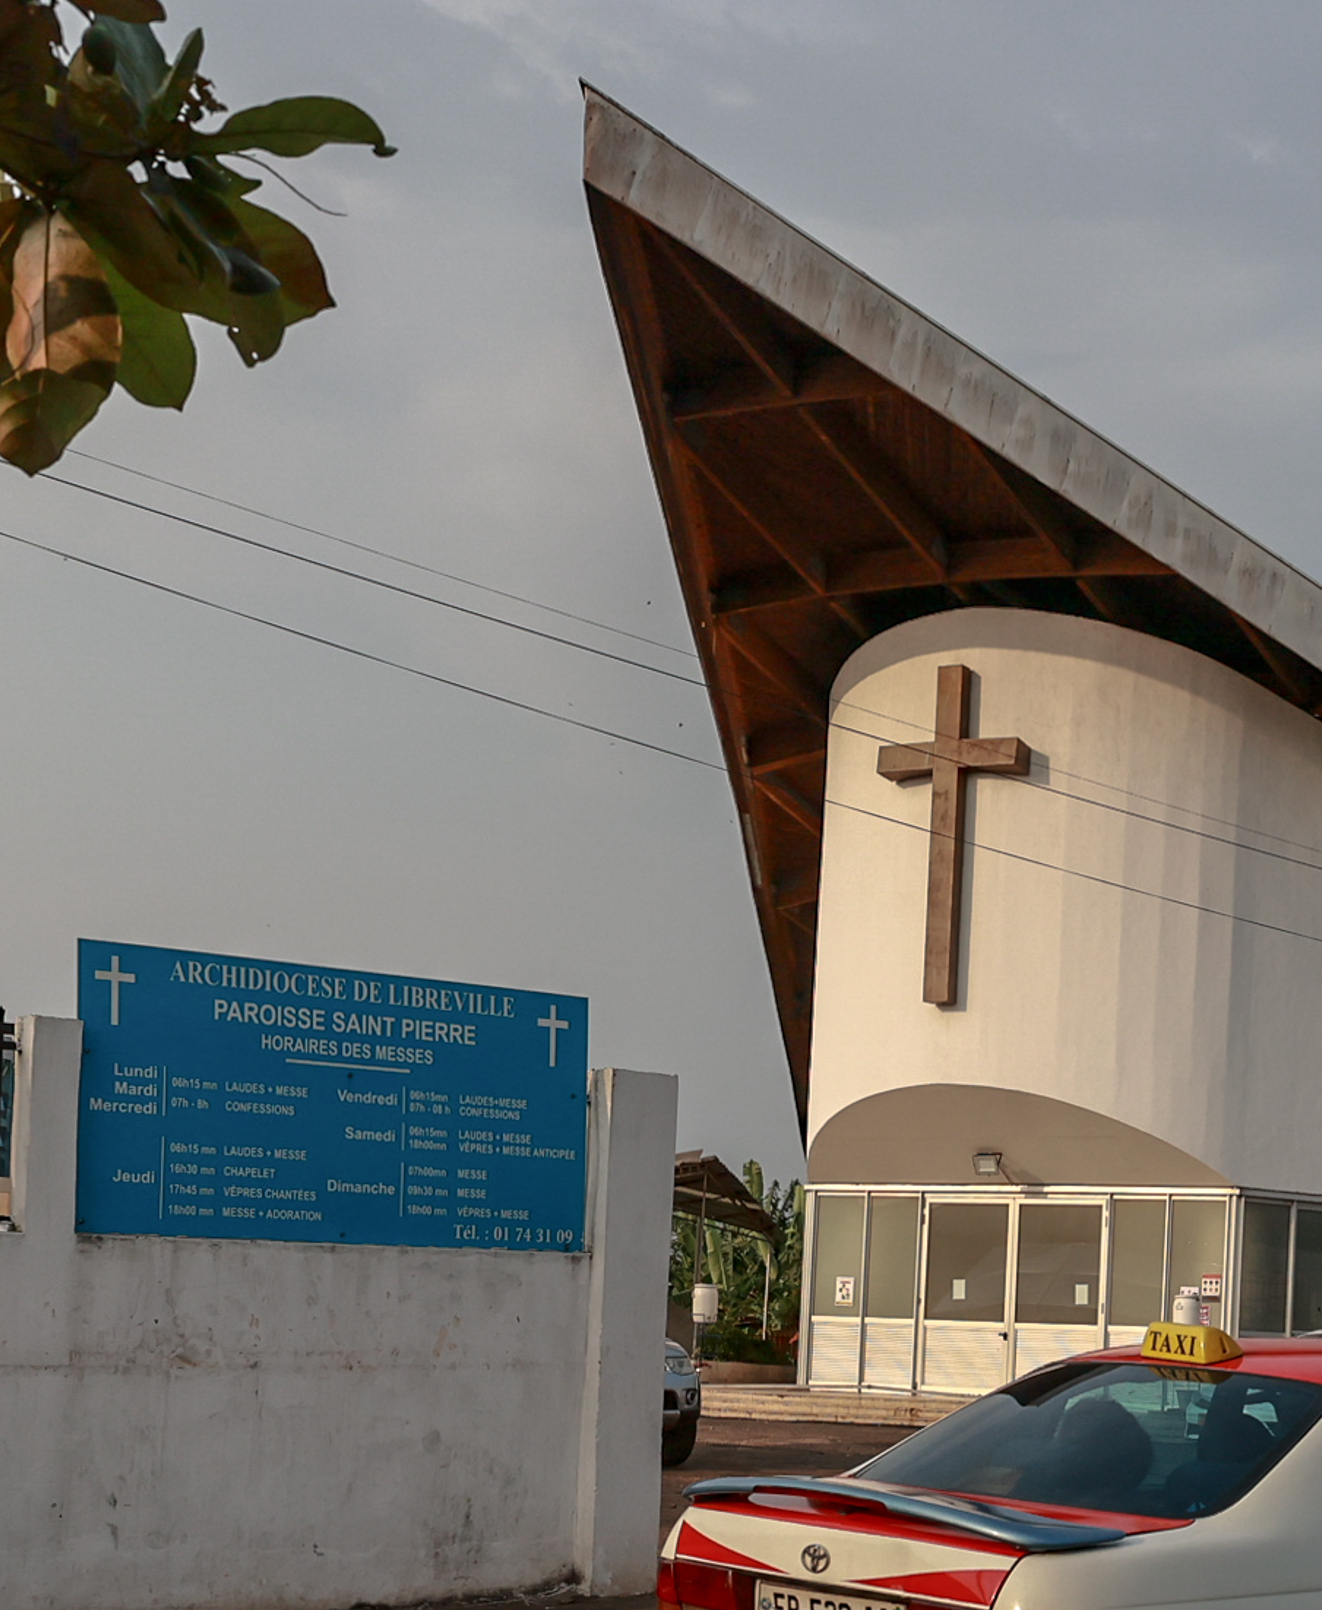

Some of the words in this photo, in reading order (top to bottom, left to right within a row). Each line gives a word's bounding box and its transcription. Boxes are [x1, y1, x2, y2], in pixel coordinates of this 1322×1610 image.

[169, 960, 347, 1000] ARCHIDIOCESE
[353, 980, 383, 1004] DE
[388, 984, 515, 1018] LIBREVILLE
[213, 999, 326, 1031] PAROISSE
[331, 1011, 395, 1038] SAINT
[401, 1018, 477, 1045] PIERRE
[260, 1034, 338, 1056] HORAIRES
[345, 1041, 371, 1060] DES
[375, 1044, 434, 1065] MESSES
[113, 1063, 158, 1079] Lundi
[114, 1081, 158, 1097] Mardi
[202, 1081, 218, 1090] mn
[225, 1081, 265, 1095] LAUDES
[275, 1085, 309, 1098] MESSE
[337, 1089, 398, 1106] Vendredi
[89, 1097, 158, 1115] Mercredi
[171, 1097, 189, 1108] 07h
[225, 1100, 295, 1116] CONFESSIONS
[459, 1106, 521, 1121] CONFESSIONS
[344, 1126, 396, 1142] Samedi
[458, 1130, 494, 1142] LAUDES
[502, 1132, 532, 1144] MESSE
[200, 1146, 217, 1155] mn
[223, 1145, 264, 1158] LAUDES
[274, 1148, 307, 1161] MESSE
[502, 1144, 532, 1157] MESSE
[112, 1169, 155, 1184] Jeudi
[199, 1167, 216, 1175] mn
[223, 1166, 276, 1179] CHAPELET
[457, 1168, 488, 1181] MESSE
[168, 1184, 198, 1196] 17h45
[199, 1187, 215, 1196] mn
[264, 1186, 317, 1201] CHANTÉES
[326, 1179, 396, 1196] Dimanche
[435, 1188, 449, 1197] mn
[457, 1187, 487, 1199] MESSE
[198, 1208, 214, 1216] mn
[222, 1206, 256, 1219] MESSE
[265, 1208, 322, 1222] ADORATION
[434, 1207, 447, 1216] mn
[501, 1209, 530, 1221] MESSE
[453, 1223, 480, 1240] Tél.
[493, 1226, 510, 1242] 01
[515, 1227, 532, 1243] 74
[536, 1227, 551, 1243] 31
[556, 1228, 573, 1244] 09
[1149, 1331, 1197, 1356] TAXI
